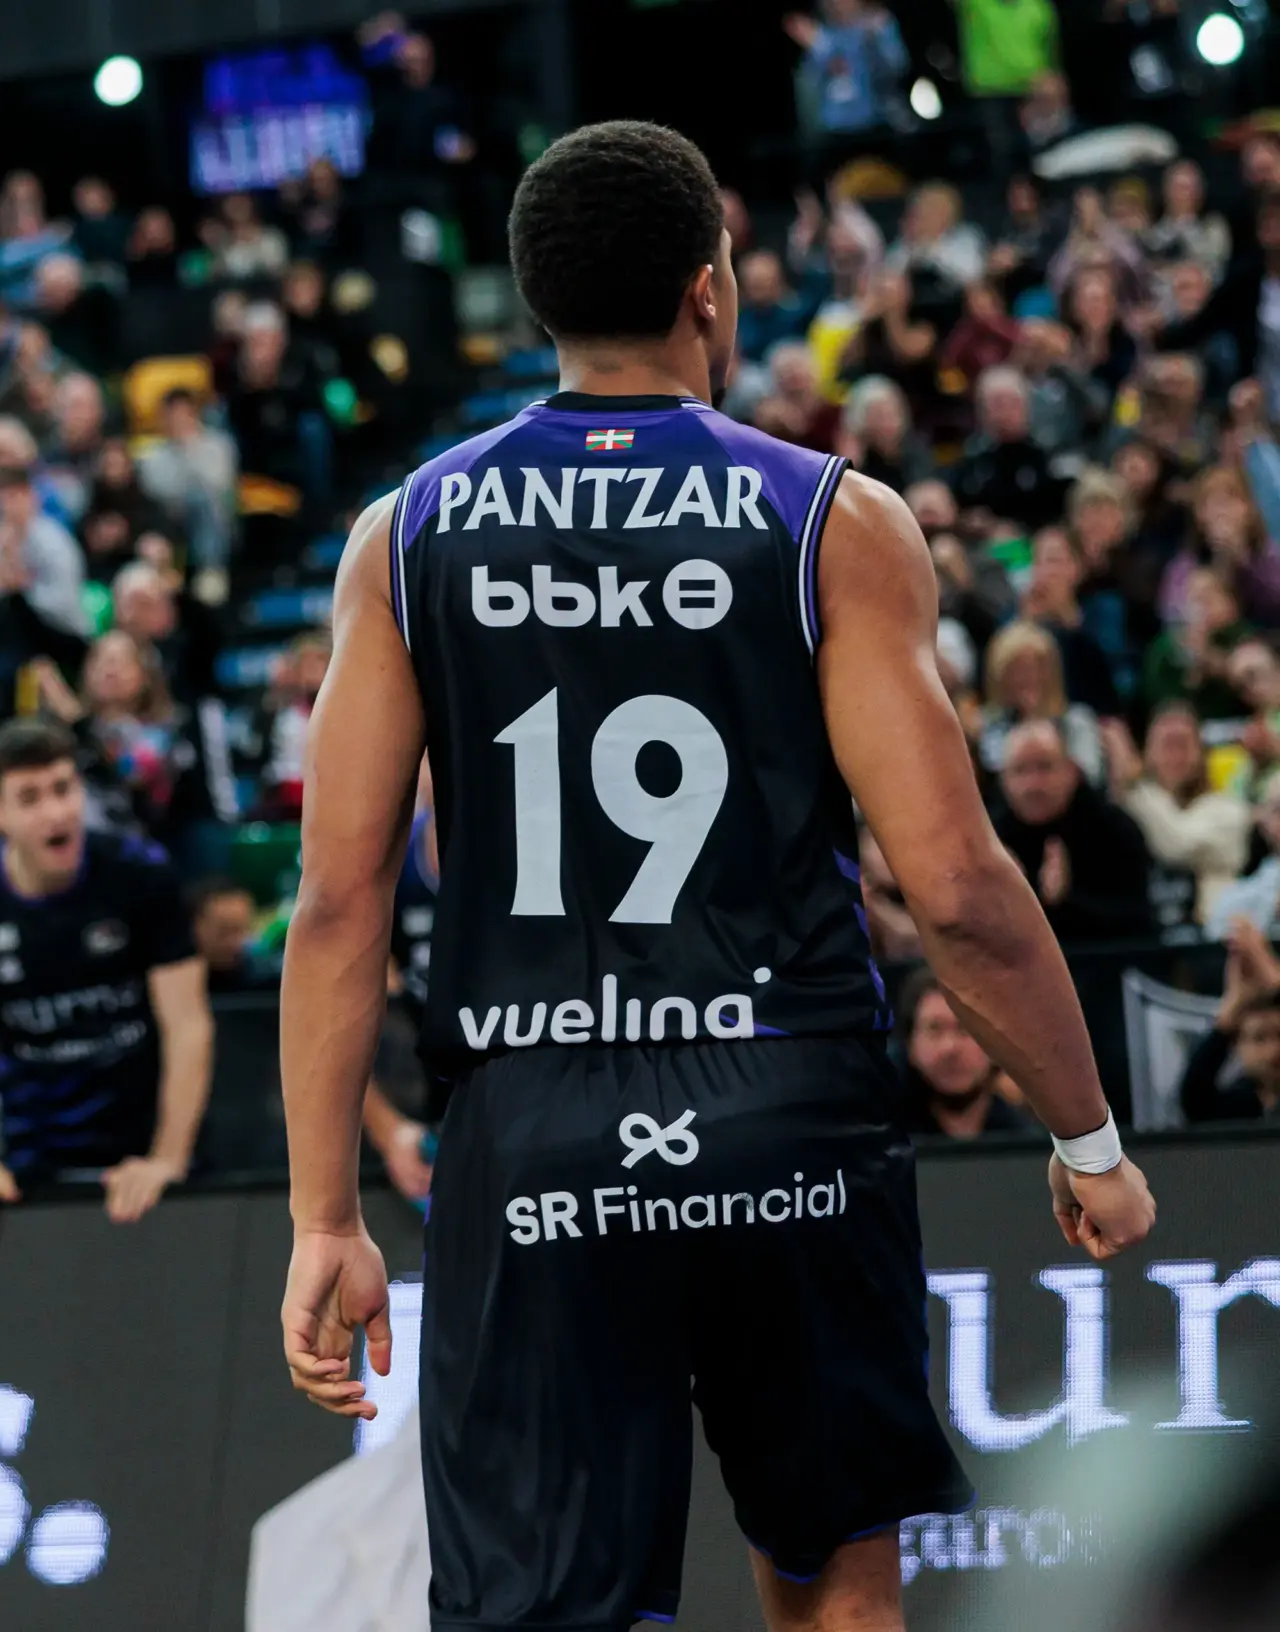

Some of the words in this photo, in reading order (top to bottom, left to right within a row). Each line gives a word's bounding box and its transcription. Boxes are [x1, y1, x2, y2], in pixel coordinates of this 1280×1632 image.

[436, 464, 769, 534] PANTZAR
[471, 564, 654, 628] bbk
[493, 686, 729, 924] 19
[505, 1191, 583, 1245] SR
[593, 1168, 846, 1236] Financial
